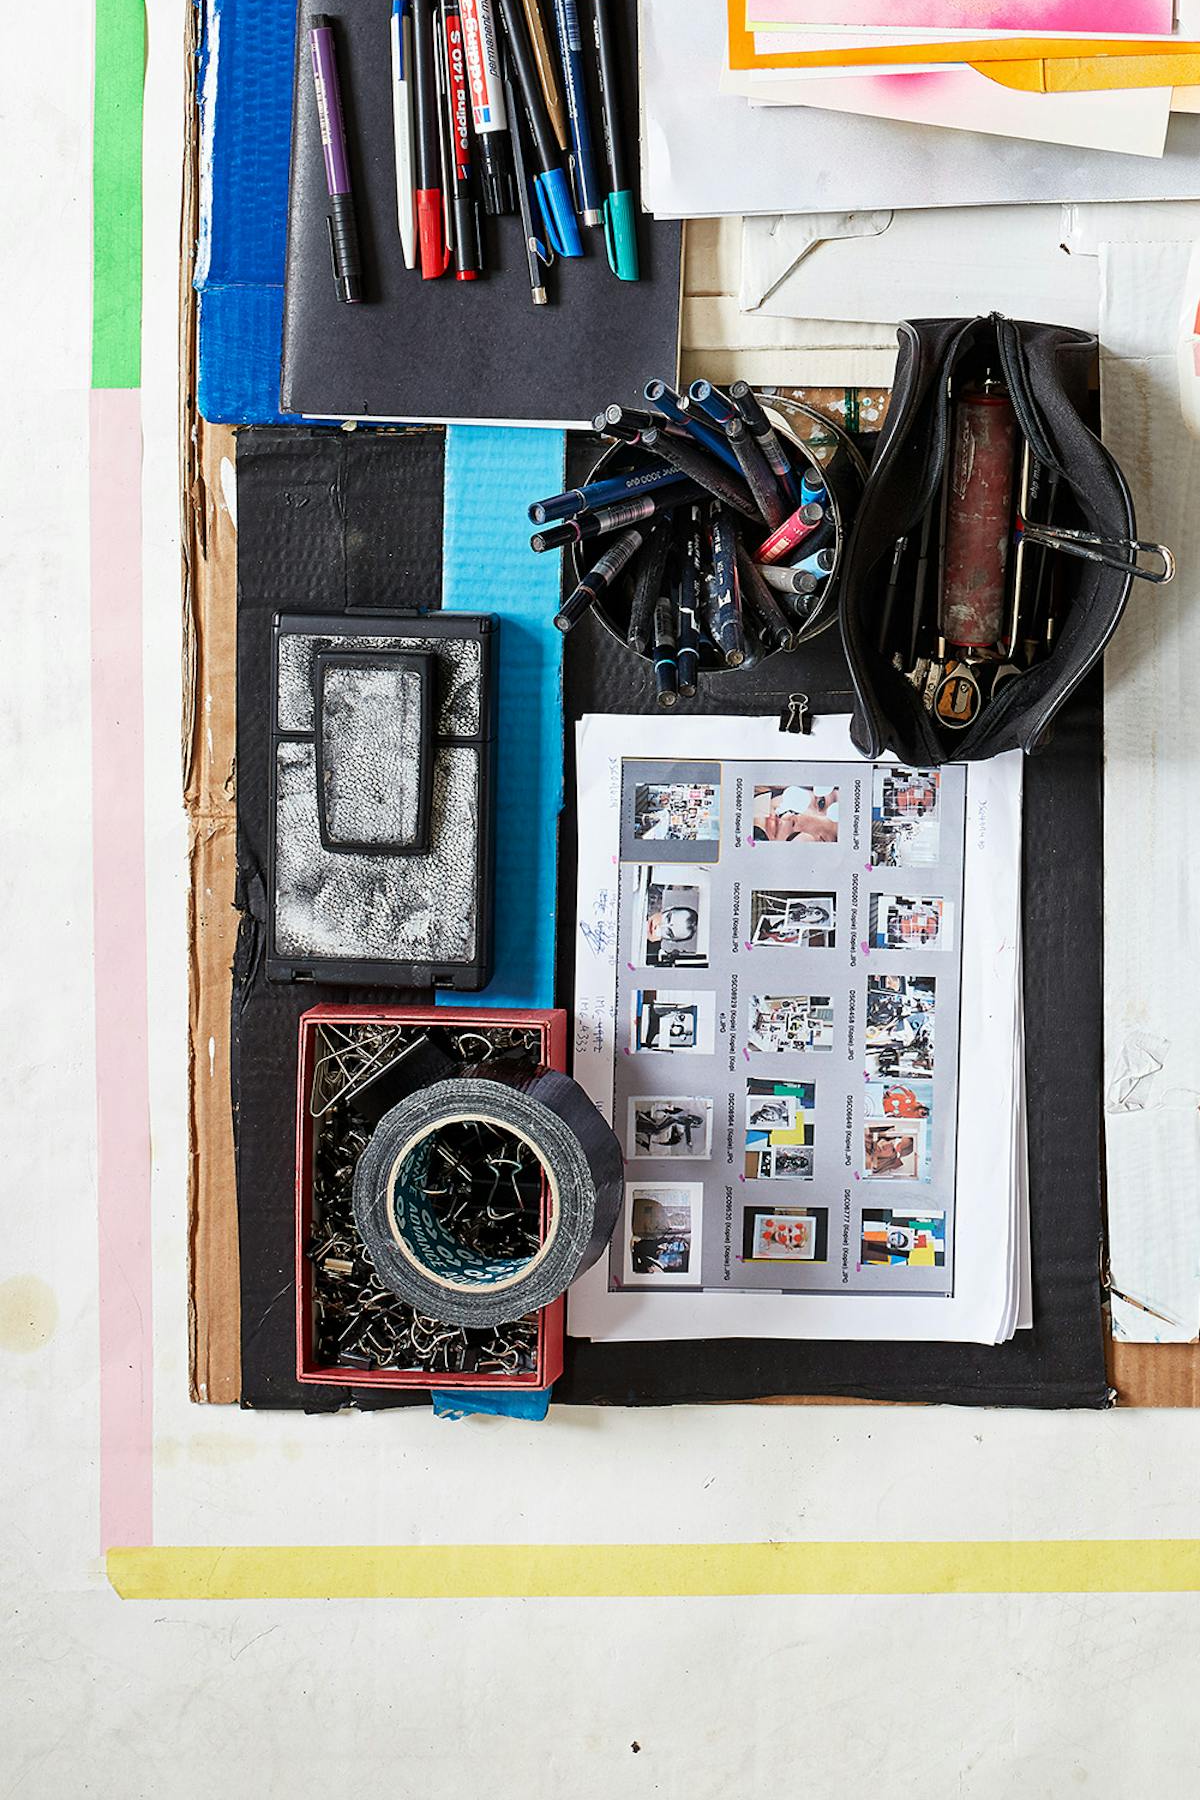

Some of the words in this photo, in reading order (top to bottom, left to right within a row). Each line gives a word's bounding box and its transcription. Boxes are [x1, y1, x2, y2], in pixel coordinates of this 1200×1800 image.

[449, 29, 462, 47] S
[452, 48, 466, 87] 140
[465, 17, 485, 96] edding
[482, 14, 501, 78] permanent
[456, 88, 470, 150] edding
